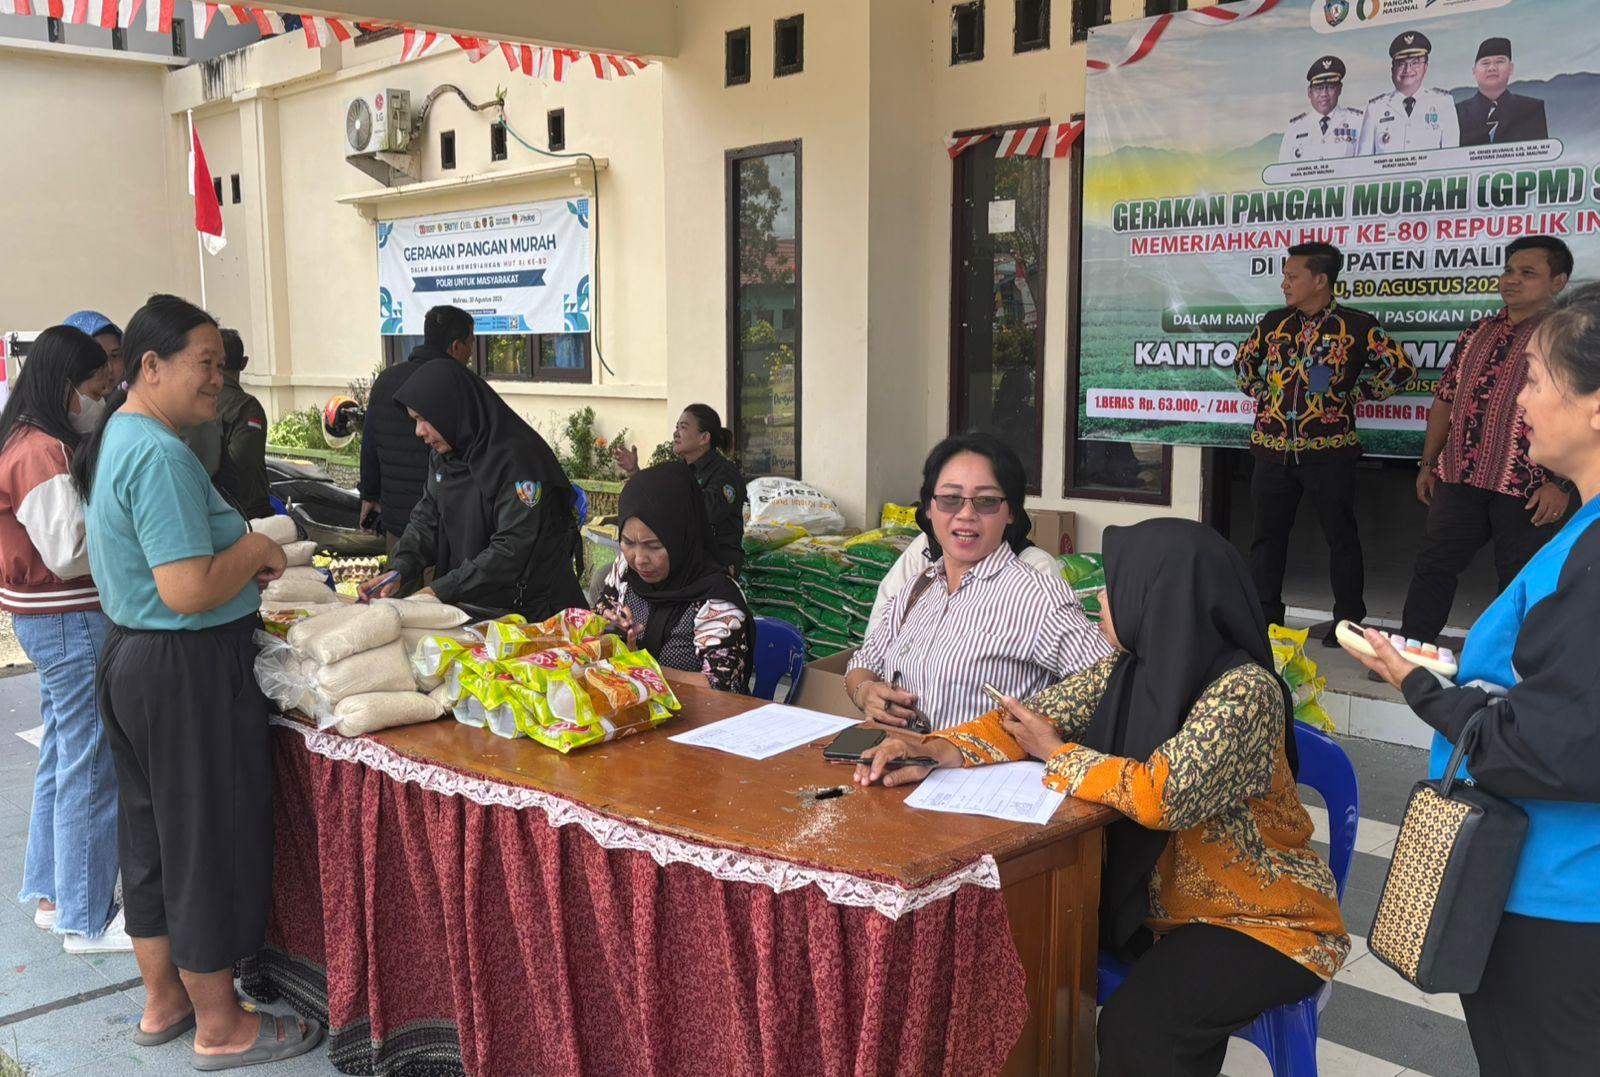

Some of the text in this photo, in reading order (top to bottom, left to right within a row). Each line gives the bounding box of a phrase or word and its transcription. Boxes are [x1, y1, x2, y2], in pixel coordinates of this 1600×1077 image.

[1382, 4, 1419, 15] NASIONAL
[1113, 195, 1226, 232] GERAKAN
[1232, 186, 1346, 224] PANGAN
[1352, 176, 1468, 216] MURAH
[1131, 211, 1600, 255] MEMERIAHKAN HUT KE-80 REPUBLIK IN
[404, 234, 556, 262] GERAKAN PANGAN MURAH
[1251, 256, 1274, 275] DI
[1434, 246, 1503, 268] MALI
[436, 274, 519, 288] POLRI UNTUK MASYARAKAT
[1354, 281, 1375, 296] 30
[1378, 279, 1462, 295] AGUSTUS
[1466, 277, 1500, 292] 202
[1173, 313, 1222, 326] DALAM
[1225, 312, 1266, 325] RANG
[1384, 309, 1464, 323] PASOKAN
[1135, 341, 1240, 366] KANTO
[1139, 397, 1156, 412] Rp.
[1216, 400, 1238, 414] ZAK
[1240, 400, 1259, 414] @5
[1355, 404, 1412, 420] GORENG
